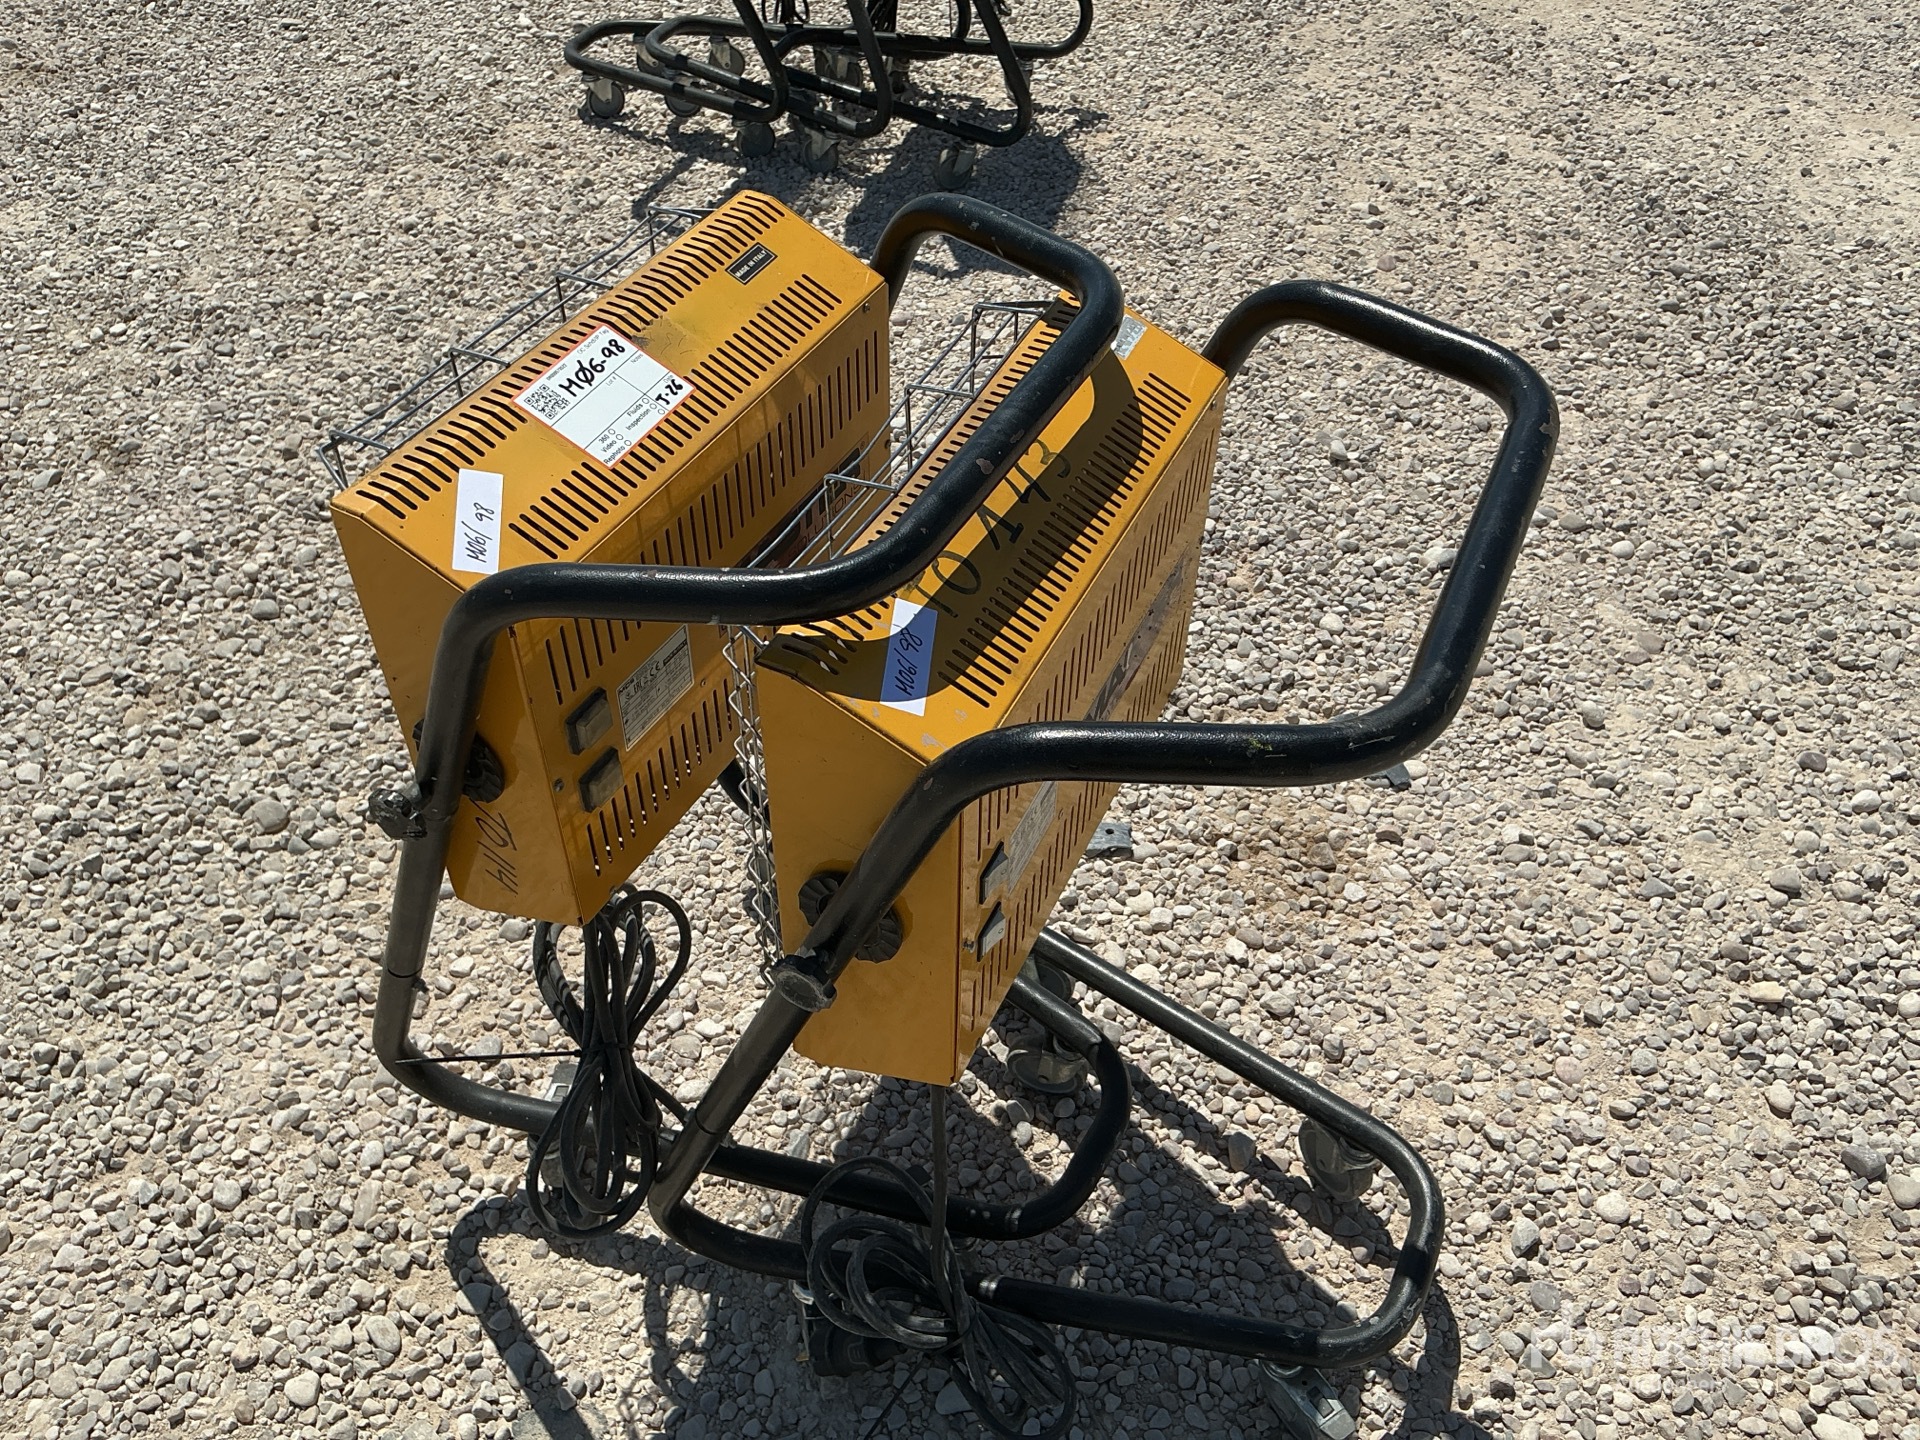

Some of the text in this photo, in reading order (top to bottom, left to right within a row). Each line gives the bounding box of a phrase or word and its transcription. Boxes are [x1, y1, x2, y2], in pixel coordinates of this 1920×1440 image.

[735, 264, 751, 278] MADE
[752, 249, 767, 263] ITALY
[630, 353, 644, 364] Notes
[626, 403, 644, 417] Fluids
[625, 408, 651, 431] Inspection
[599, 433, 610, 444] 360
[601, 439, 617, 453] Video
[603, 445, 626, 464] Rephoto
